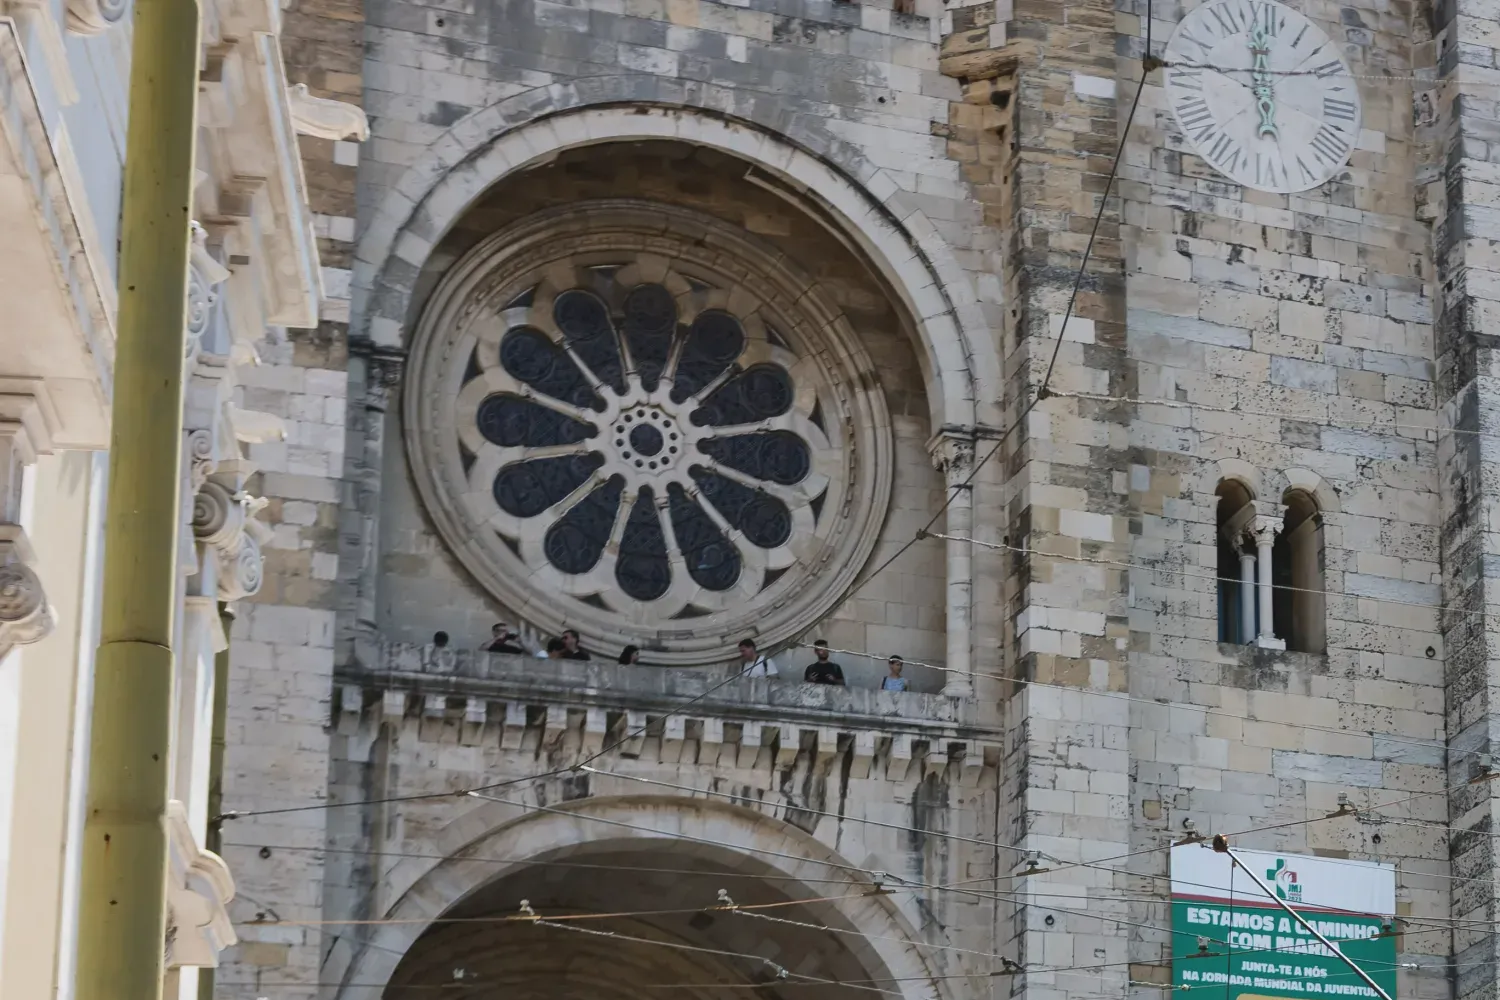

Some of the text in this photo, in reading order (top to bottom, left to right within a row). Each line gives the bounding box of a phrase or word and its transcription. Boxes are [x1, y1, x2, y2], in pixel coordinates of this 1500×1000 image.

[1290, 23, 1310, 49] I
[1176, 99, 1216, 141] VIII
[1324, 98, 1356, 120] III
[1206, 132, 1242, 173] VII
[1309, 125, 1349, 165] IIII
[1254, 153, 1279, 187] VI
[1296, 154, 1319, 185] V
[1187, 907, 1380, 942] ESTAMOS A CAMINHO
[1227, 931, 1340, 958] COM MARIA
[1183, 970, 1384, 998] NA JORNADA MUNDIAL DA JUVENTUD
[1241, 961, 1328, 979] JUNTA-TE A NÓS
